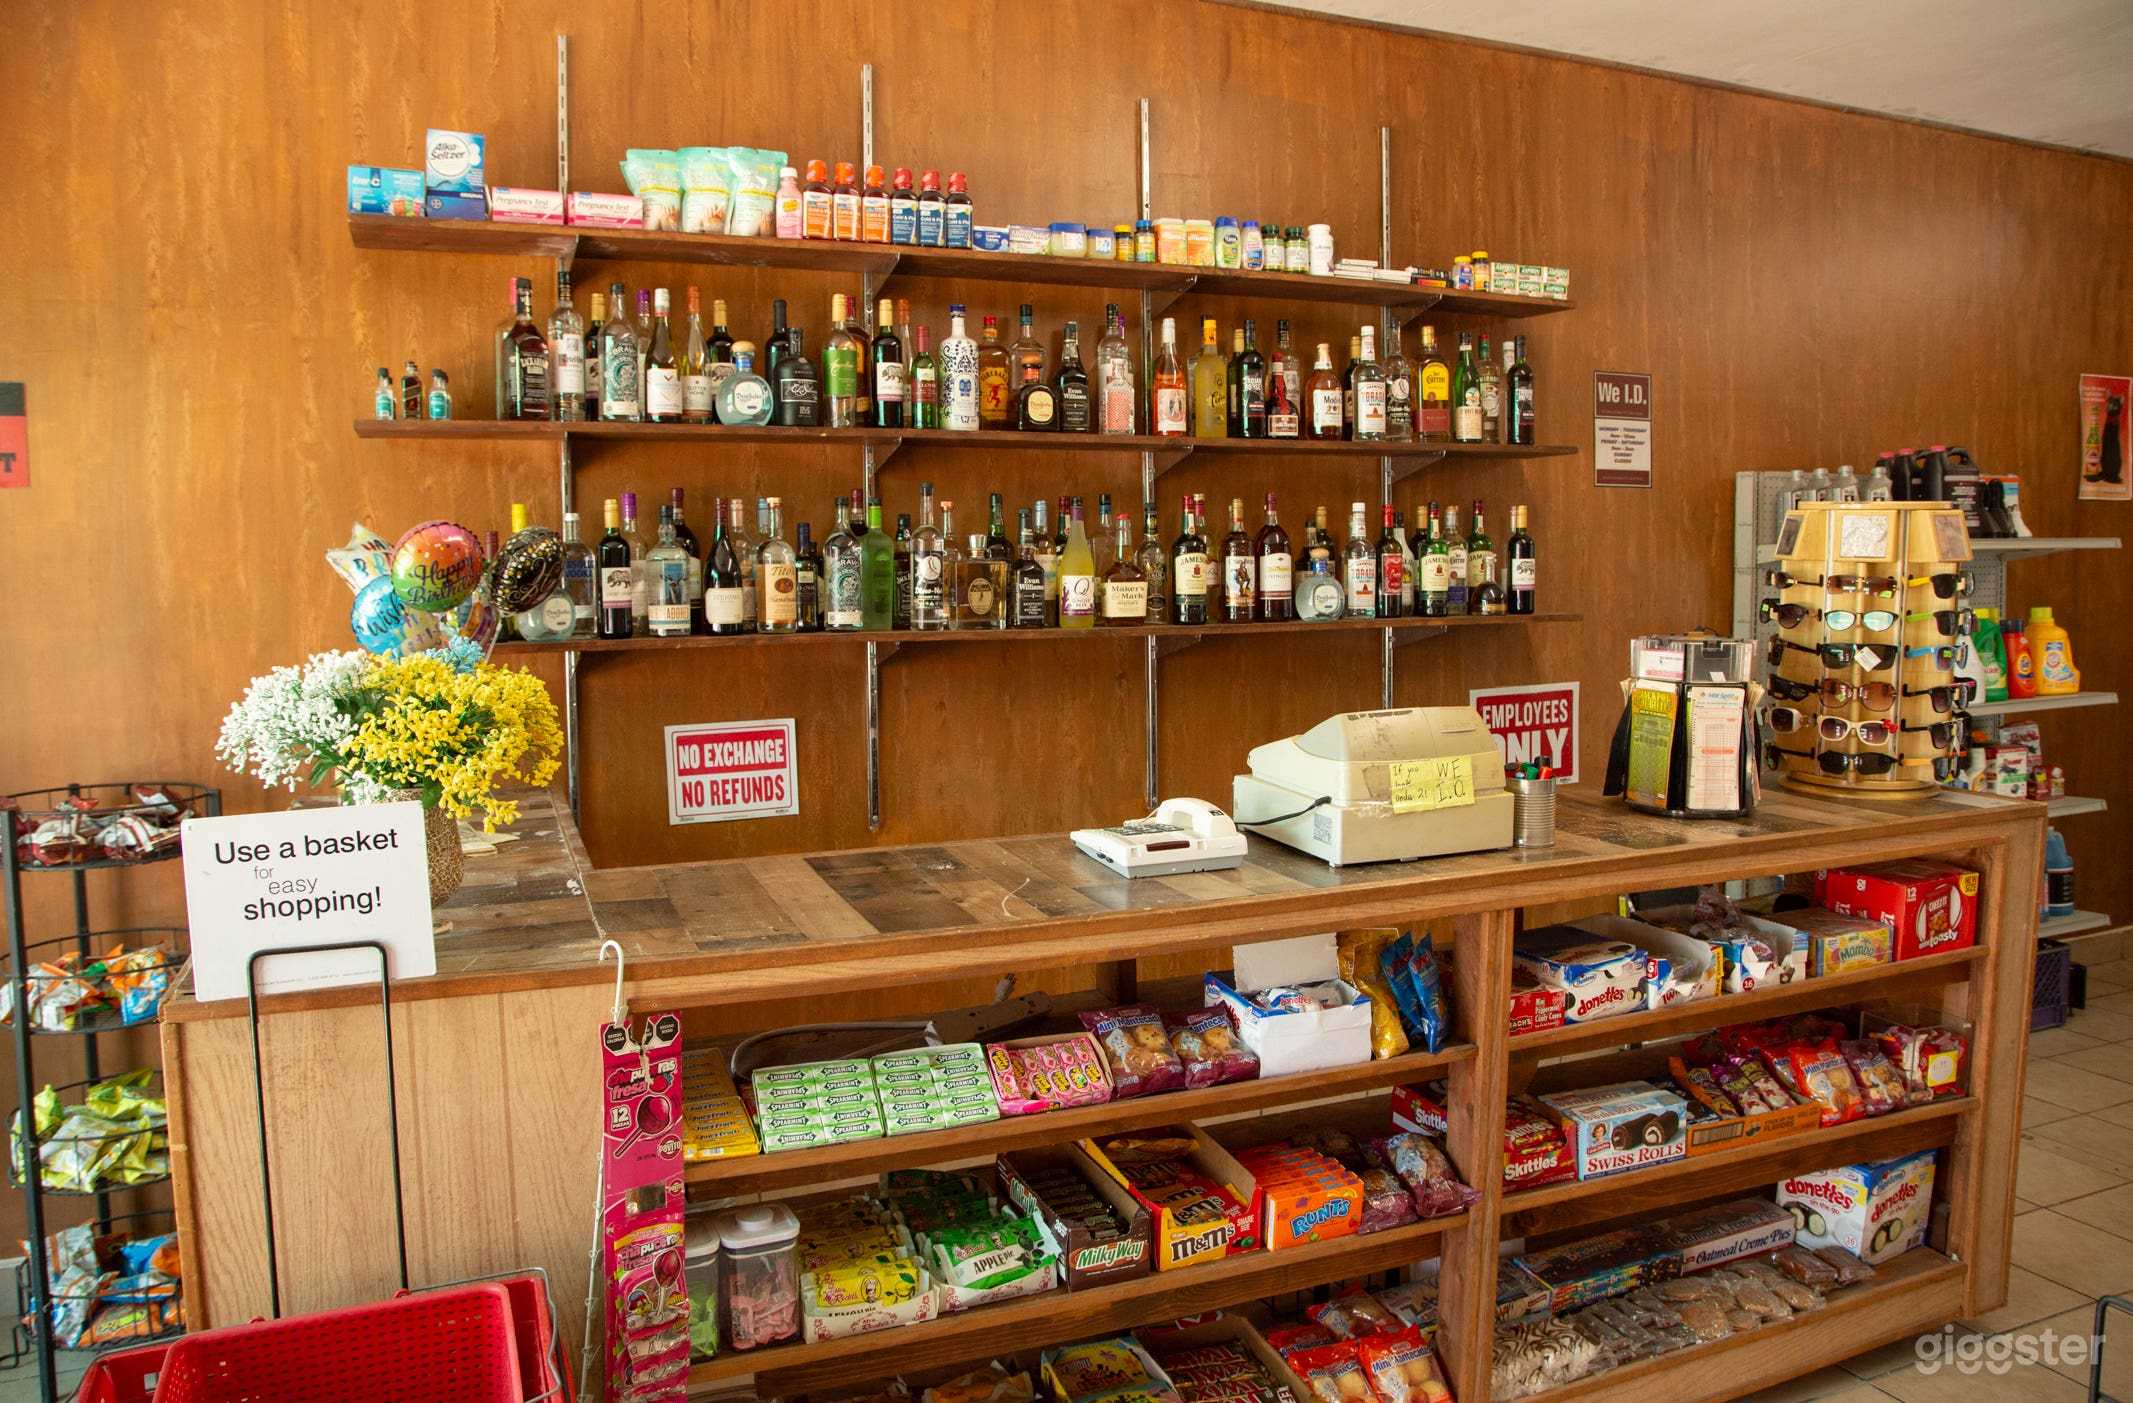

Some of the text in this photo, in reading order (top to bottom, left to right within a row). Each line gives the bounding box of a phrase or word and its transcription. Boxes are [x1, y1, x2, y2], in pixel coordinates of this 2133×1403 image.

[496, 196, 532, 206] Pregnancy
[578, 200, 613, 210] Pregnancy
[1520, 281, 1540, 290] ASPIRIN
[1598, 382, 1647, 405] We I.D.
[411, 555, 474, 586] Happy
[1019, 583, 1044, 591] Williams
[1073, 577, 1091, 597] Q
[1111, 585, 1145, 593] Maker's
[1121, 592, 1145, 600] Mark
[1482, 699, 1569, 729] EMPLOYEES
[678, 738, 785, 769] NO EXCHANGE
[1407, 765, 1420, 778] you
[682, 774, 785, 808] NO REFUNDS
[215, 829, 399, 865] Use a basket
[254, 865, 274, 880] for
[268, 877, 318, 895] easy
[1964, 875, 1977, 885] NEW
[1906, 887, 1917, 897] 12
[1965, 884, 1978, 893] SIZE
[244, 886, 382, 921] shopping!
[1929, 930, 1958, 947] toasty
[1839, 944, 1875, 961] Mamba
[1743, 980, 1753, 989] 16
[1281, 995, 1311, 1006] donettes
[1535, 998, 1545, 1006] Mini
[1577, 986, 1625, 1017] donettes
[1535, 1013, 1548, 1022] Candy
[1098, 1020, 1117, 1033] Mini
[886, 1058, 917, 1068] SPEARMINT
[939, 1052, 968, 1062] SPEARMINT
[608, 1059, 677, 1086] chapueras
[824, 1064, 855, 1076] SPEARMINT
[946, 1064, 976, 1075] SPEARMINT
[1804, 1064, 1821, 1077] Mini
[770, 1072, 802, 1082] SPEARMINT
[888, 1073, 919, 1083] SPEARMINT
[946, 1077, 976, 1089] SPEARMINT
[827, 1079, 858, 1090] SPEARMINT
[612, 1081, 647, 1101] fresa
[773, 1086, 805, 1098] SPEARMINT
[893, 1088, 923, 1097] SPEARMINT
[829, 1094, 861, 1105] SPEARMINT
[954, 1093, 984, 1104] SPEARMINT
[771, 1101, 803, 1112] SPEARMINT
[896, 1101, 927, 1112] SPEARMINT
[612, 1106, 629, 1123] 12
[693, 1110, 730, 1121] Juicy Fruit
[837, 1110, 869, 1121] SPEARMINT
[956, 1107, 986, 1119] SPEARMINT
[715, 1120, 733, 1128] Fruit
[773, 1116, 806, 1127] SPEARMINT
[900, 1115, 931, 1126] SPEARMINT
[1415, 1110, 1448, 1132] Skittle
[700, 1129, 738, 1140] Juicy Fruit
[835, 1123, 867, 1134] SPEARMINT
[780, 1133, 814, 1144] SPEARMINT
[1504, 1156, 1558, 1181] Skittles
[1784, 1177, 1853, 1210] donettes
[1809, 1199, 1840, 1215] on the go
[1871, 1182, 1919, 1223] donettes
[1237, 1215, 1254, 1226] SHARE
[1290, 1197, 1352, 1239] RUNTS
[1240, 1224, 1251, 1233] SIZE
[1170, 1222, 1235, 1263] m&m's
[1695, 1227, 1792, 1265] Oatmeal Creme Pies
[1076, 1240, 1146, 1271] Milky Way
[623, 1254, 654, 1272] fresa
[973, 1249, 1014, 1275] APPLE pie
[1372, 1358, 1392, 1374] Mini
